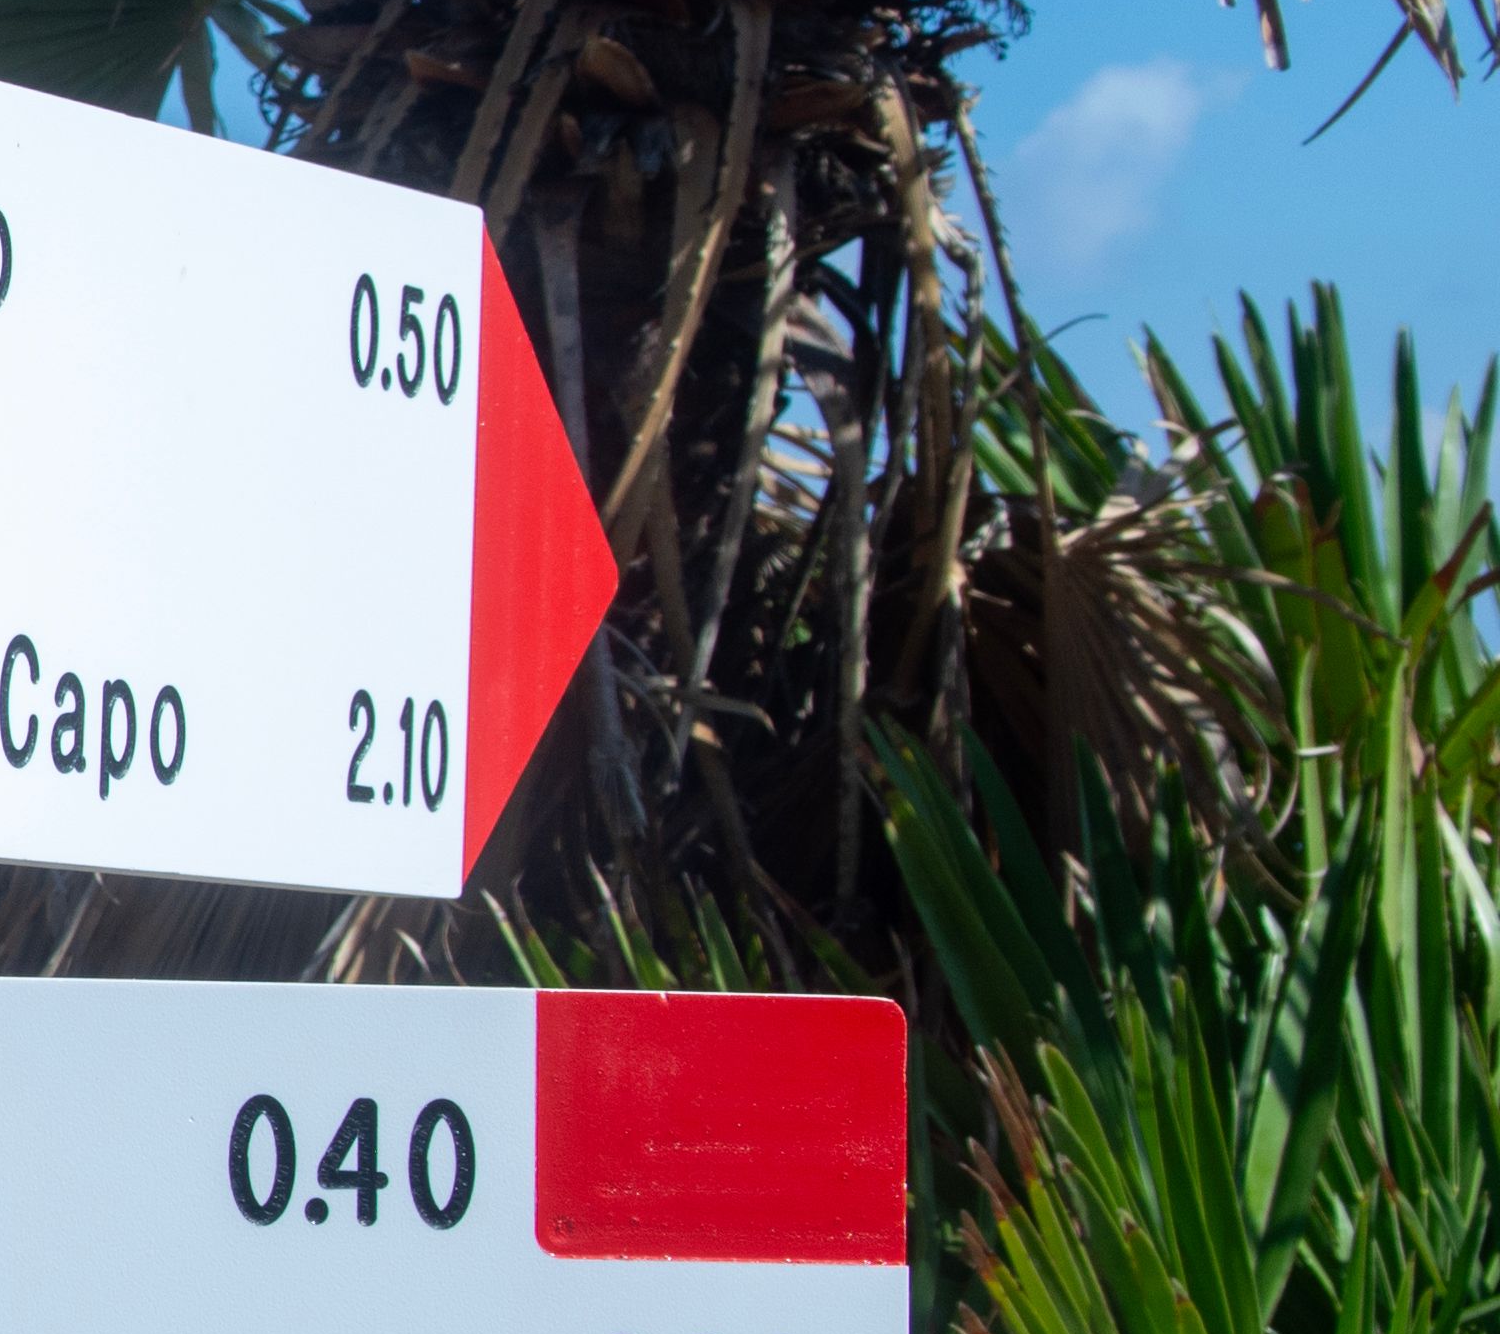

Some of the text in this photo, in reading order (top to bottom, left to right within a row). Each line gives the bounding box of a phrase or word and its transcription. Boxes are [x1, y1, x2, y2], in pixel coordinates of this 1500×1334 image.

[349, 272, 462, 407] 0.50
[345, 688, 449, 814] 2.10
[227, 1092, 477, 1232] 0.40
